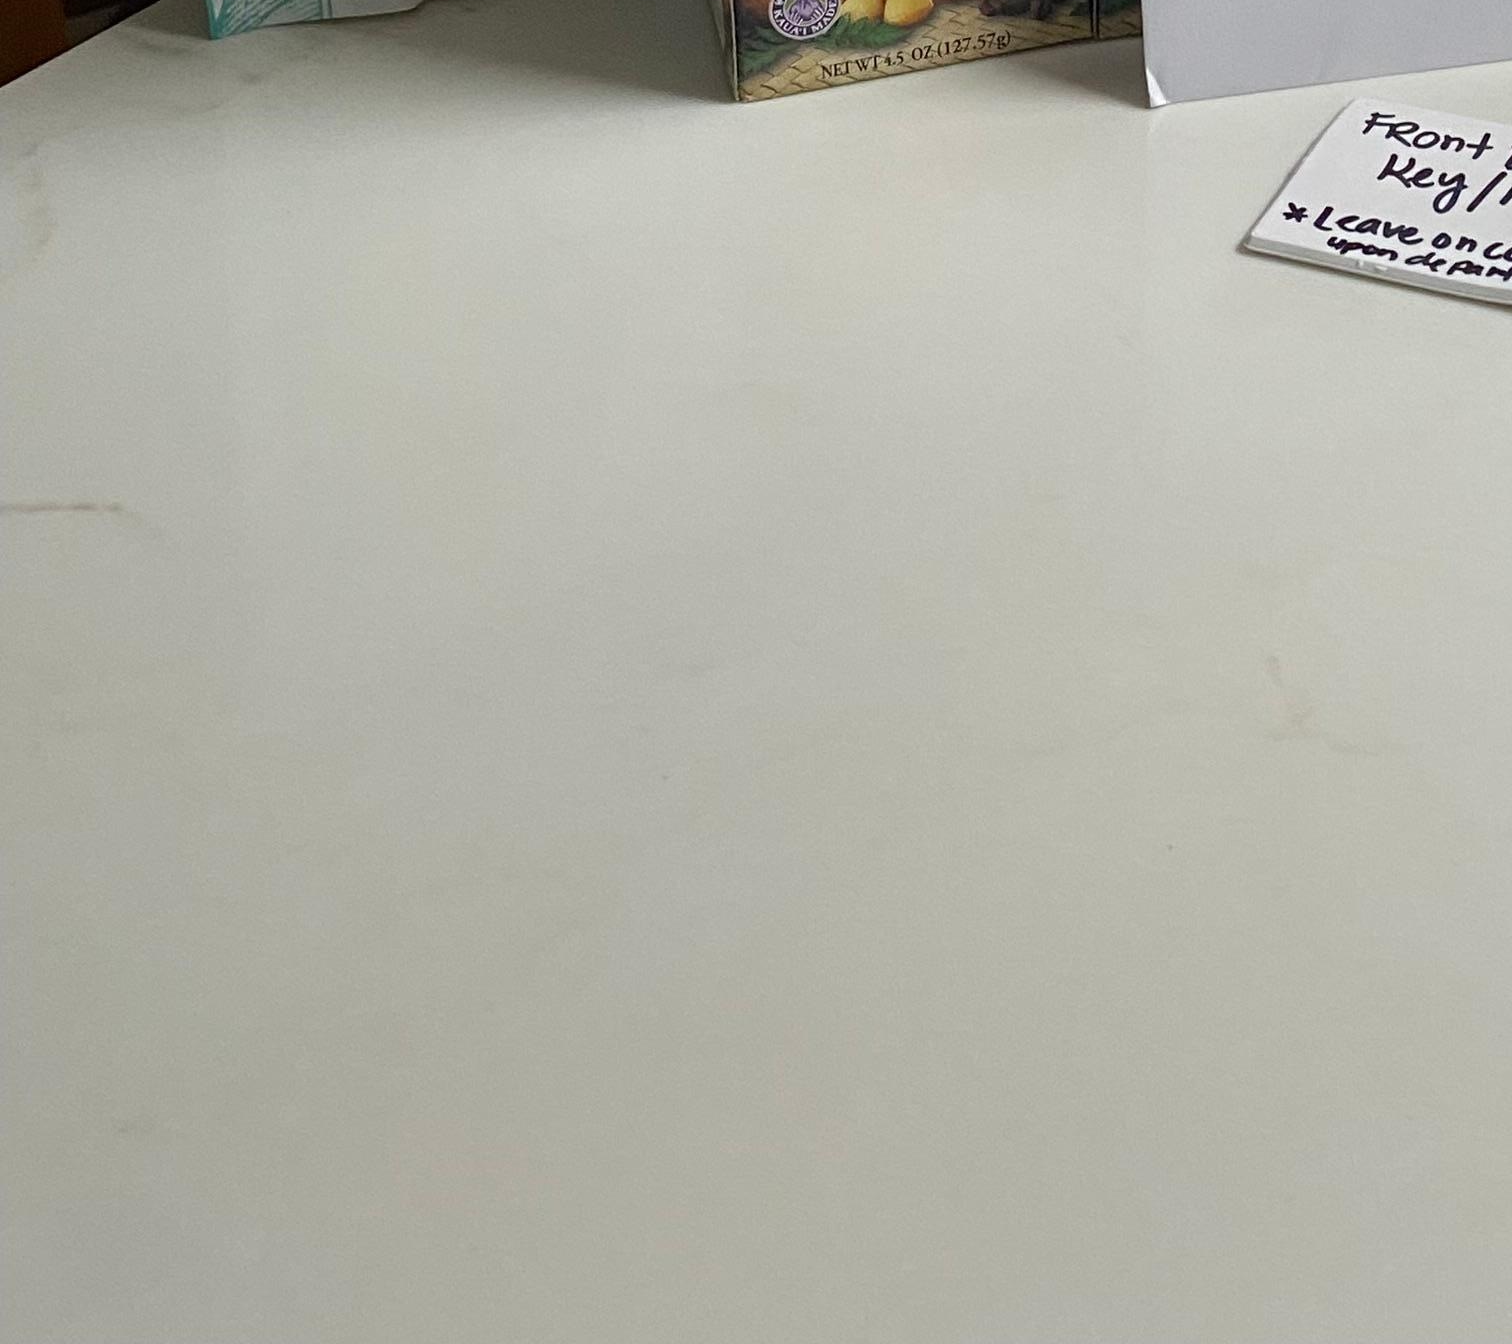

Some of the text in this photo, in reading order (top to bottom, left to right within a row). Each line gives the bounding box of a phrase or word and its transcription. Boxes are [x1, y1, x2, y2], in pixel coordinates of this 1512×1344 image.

[821, 30, 1012, 80] NET WT 4.5 OZ (127.57g)
[1326, 236, 1398, 261] upon
[1432, 232, 1476, 256] on
